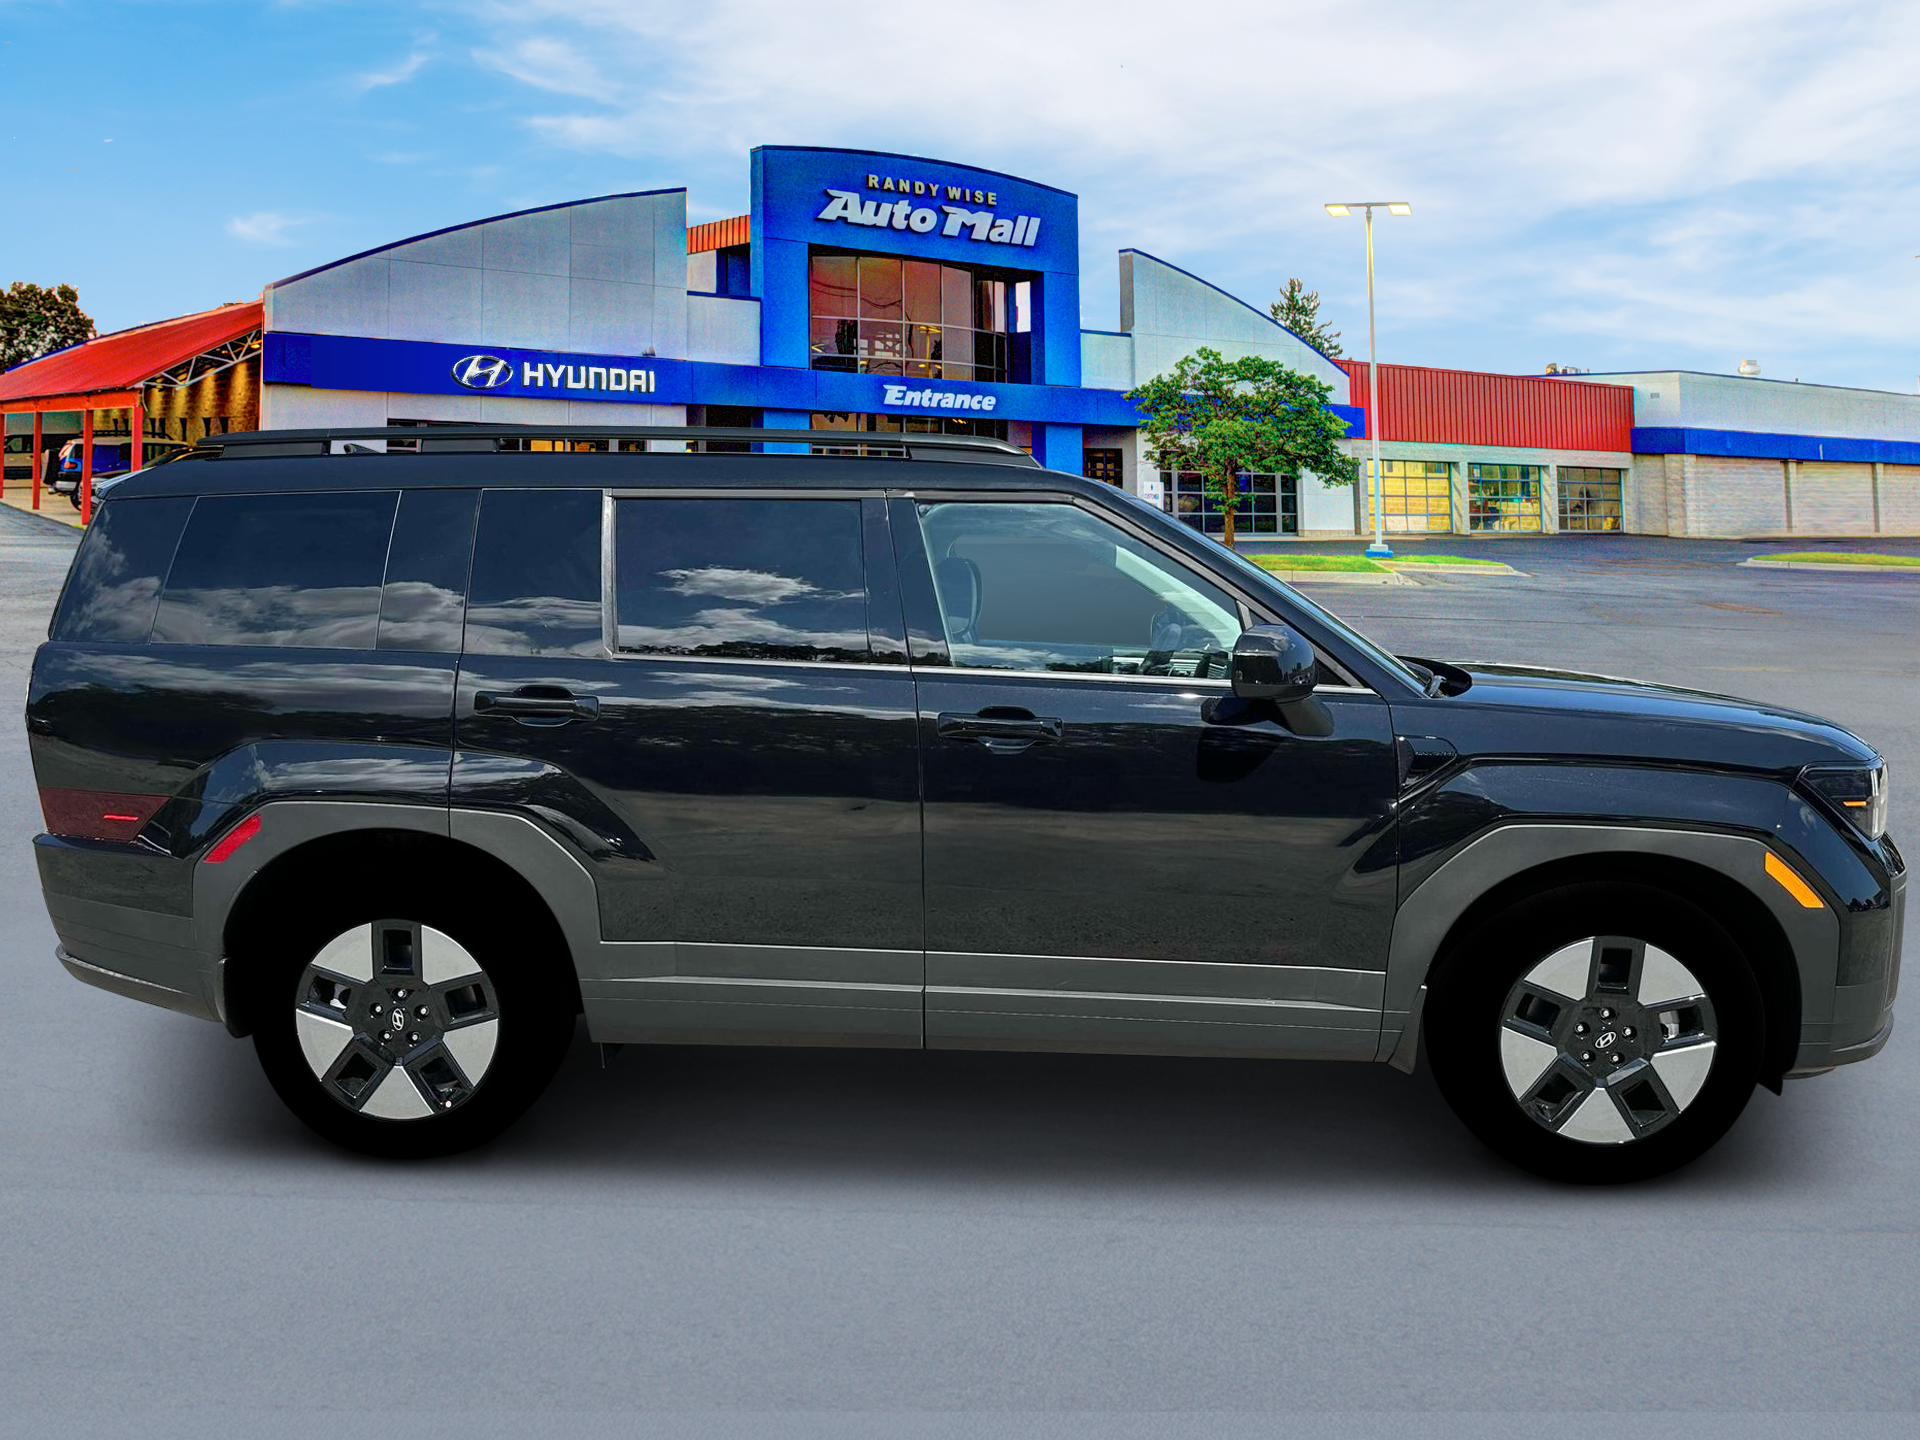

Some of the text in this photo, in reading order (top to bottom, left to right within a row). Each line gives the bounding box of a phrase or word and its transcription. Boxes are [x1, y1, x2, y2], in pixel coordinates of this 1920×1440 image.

[867, 173, 998, 206] RANDY WISE
[816, 188, 1041, 246] Auto Mall
[522, 361, 655, 393] HYUNDAI
[883, 384, 996, 411] Entrance
